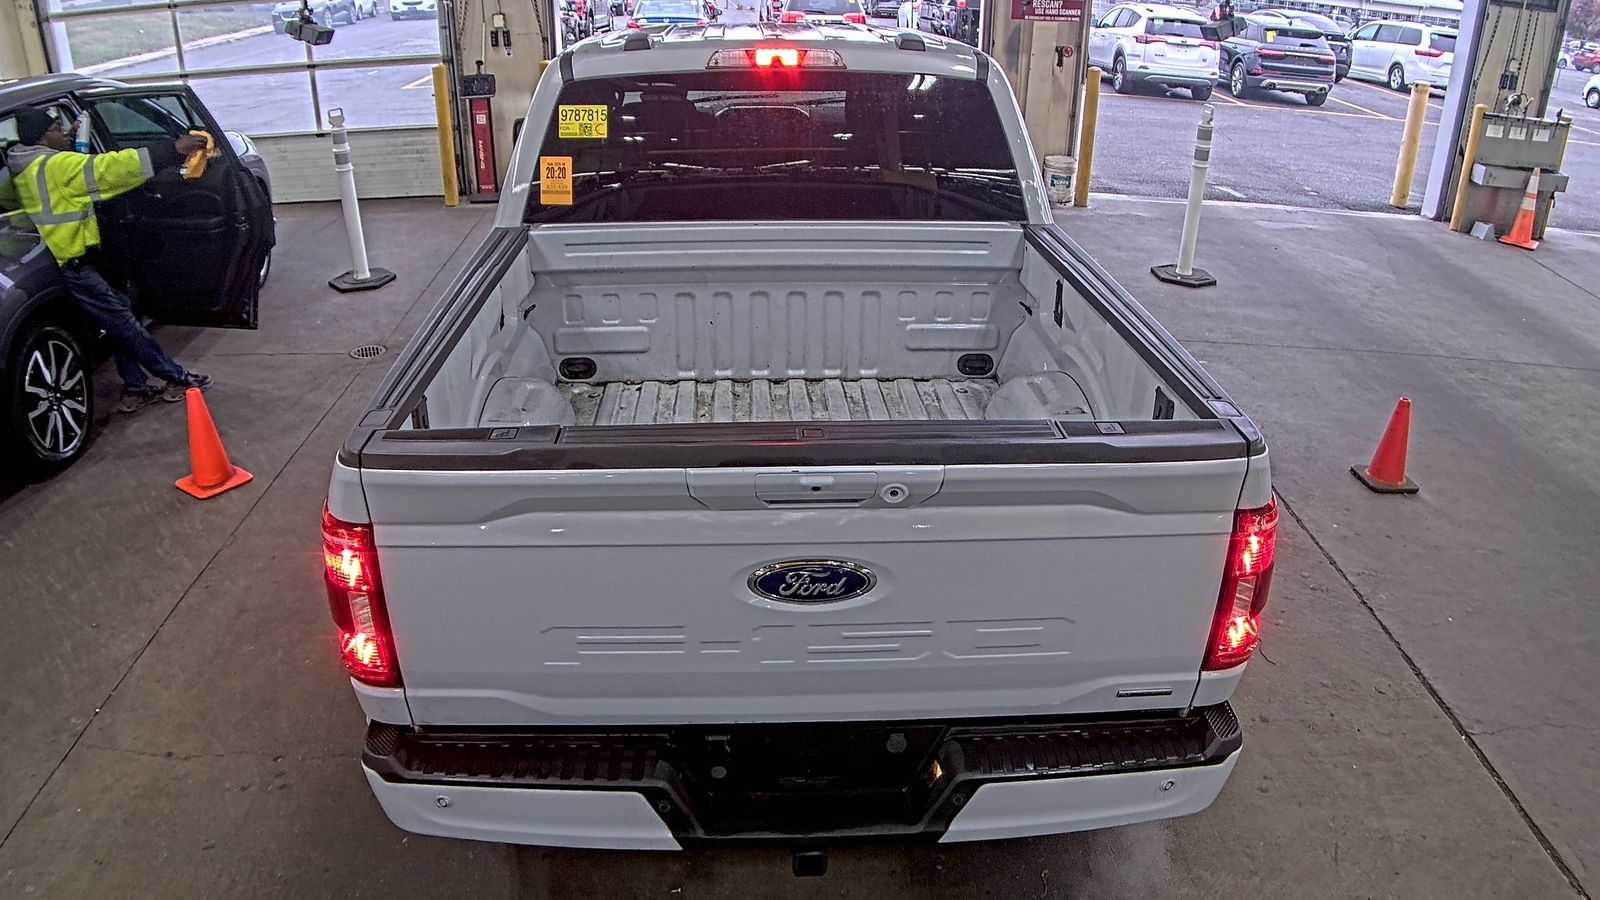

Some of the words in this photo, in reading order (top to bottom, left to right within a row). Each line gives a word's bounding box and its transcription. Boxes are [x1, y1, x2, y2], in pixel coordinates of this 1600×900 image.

[1032, 0, 1063, 8] RESCAN?
[561, 108, 607, 122] 9787815
[546, 166, 567, 179] 20:20
[779, 571, 848, 595] Ford
